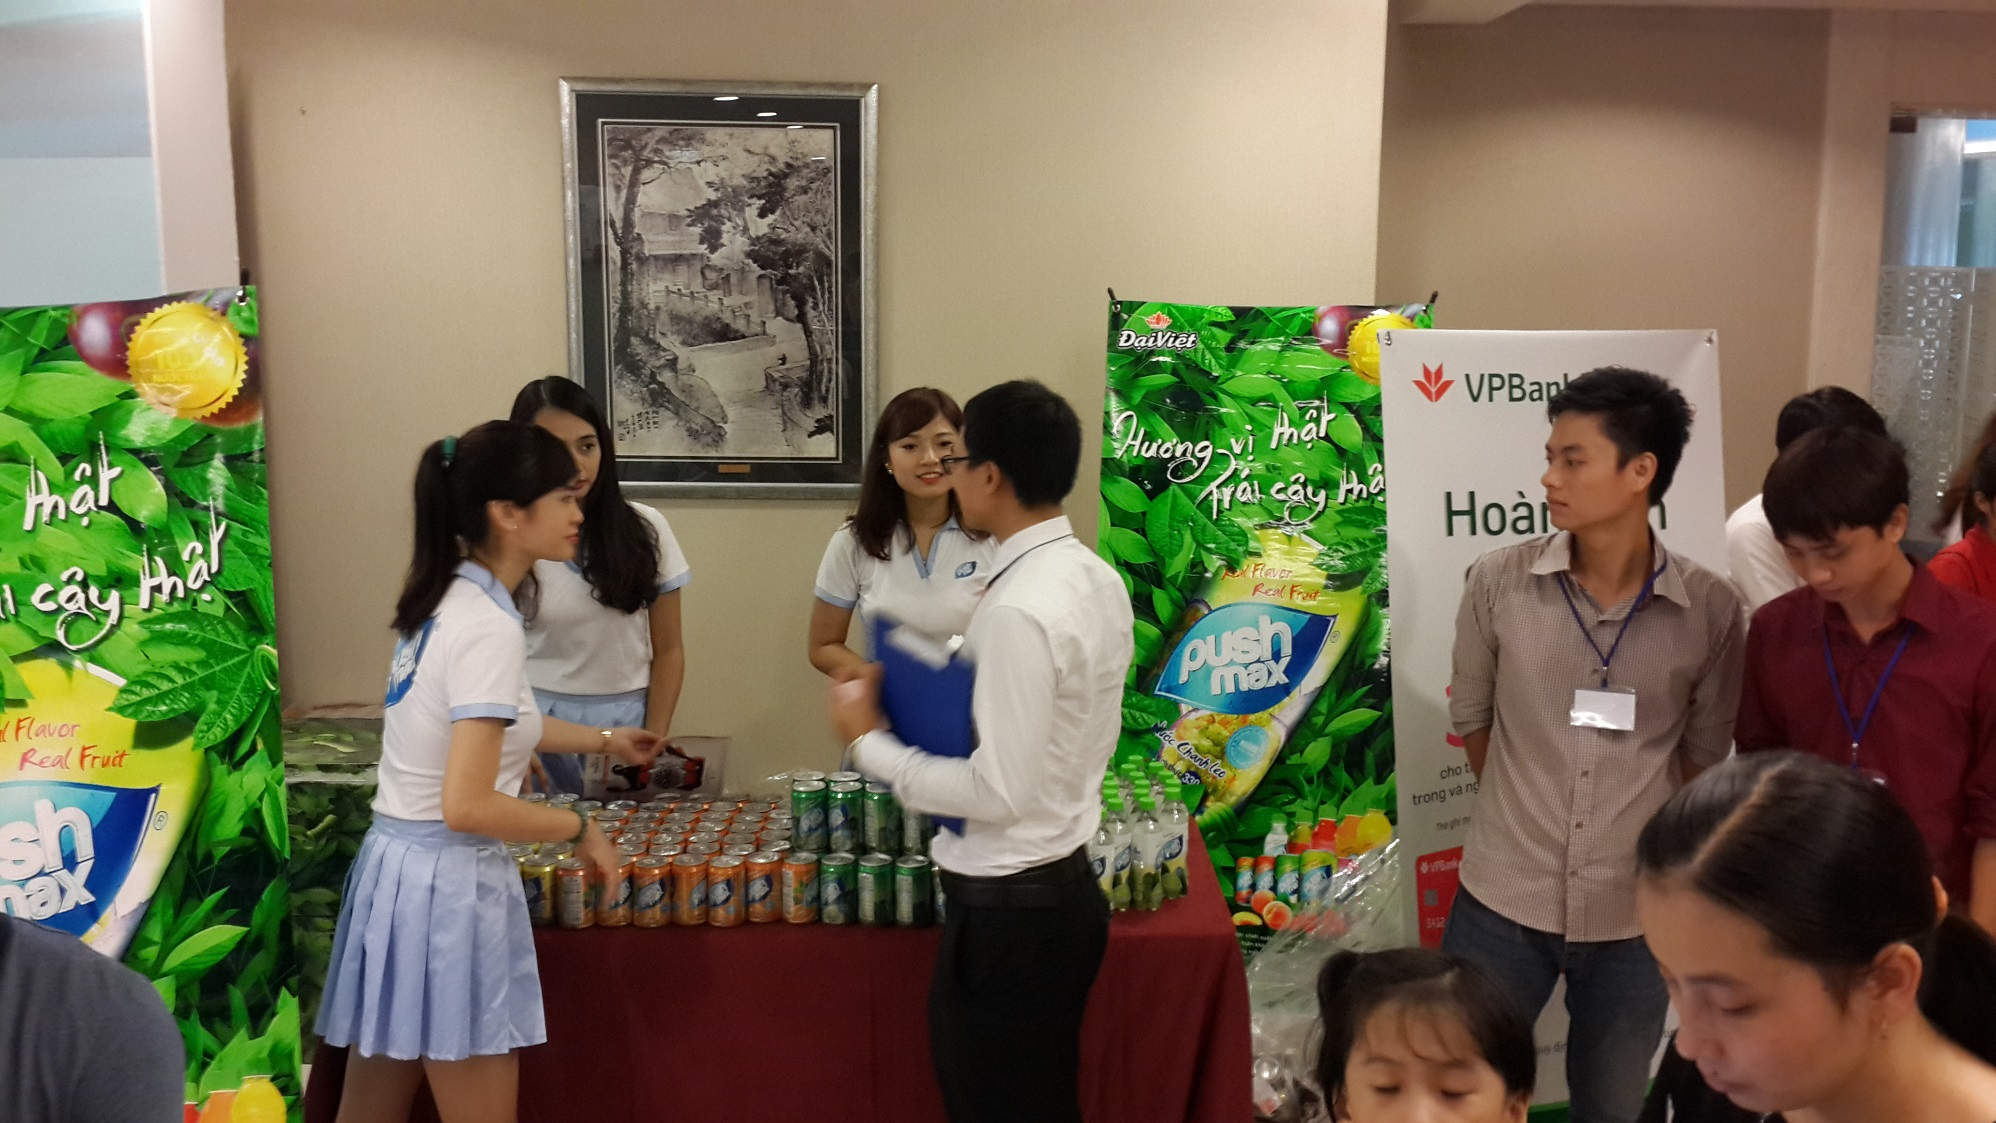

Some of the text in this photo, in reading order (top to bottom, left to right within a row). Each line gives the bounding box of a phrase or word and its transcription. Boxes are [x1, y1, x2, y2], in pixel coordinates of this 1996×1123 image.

[1111, 390, 1336, 483] Hương vị thật
[22, 431, 123, 531] thật
[1270, 473, 1327, 525] cây
[31, 566, 120, 652] cây
[138, 497, 227, 611] thật
[1251, 563, 1292, 579] Flavor
[1251, 582, 1321, 601] Real Fruit
[1179, 614, 1293, 685] push
[1210, 656, 1290, 696] max
[14, 716, 80, 742] Flavor
[18, 745, 131, 771] Real Fruit
[1440, 765, 1462, 780] cho
[1412, 789, 1447, 806] trong
